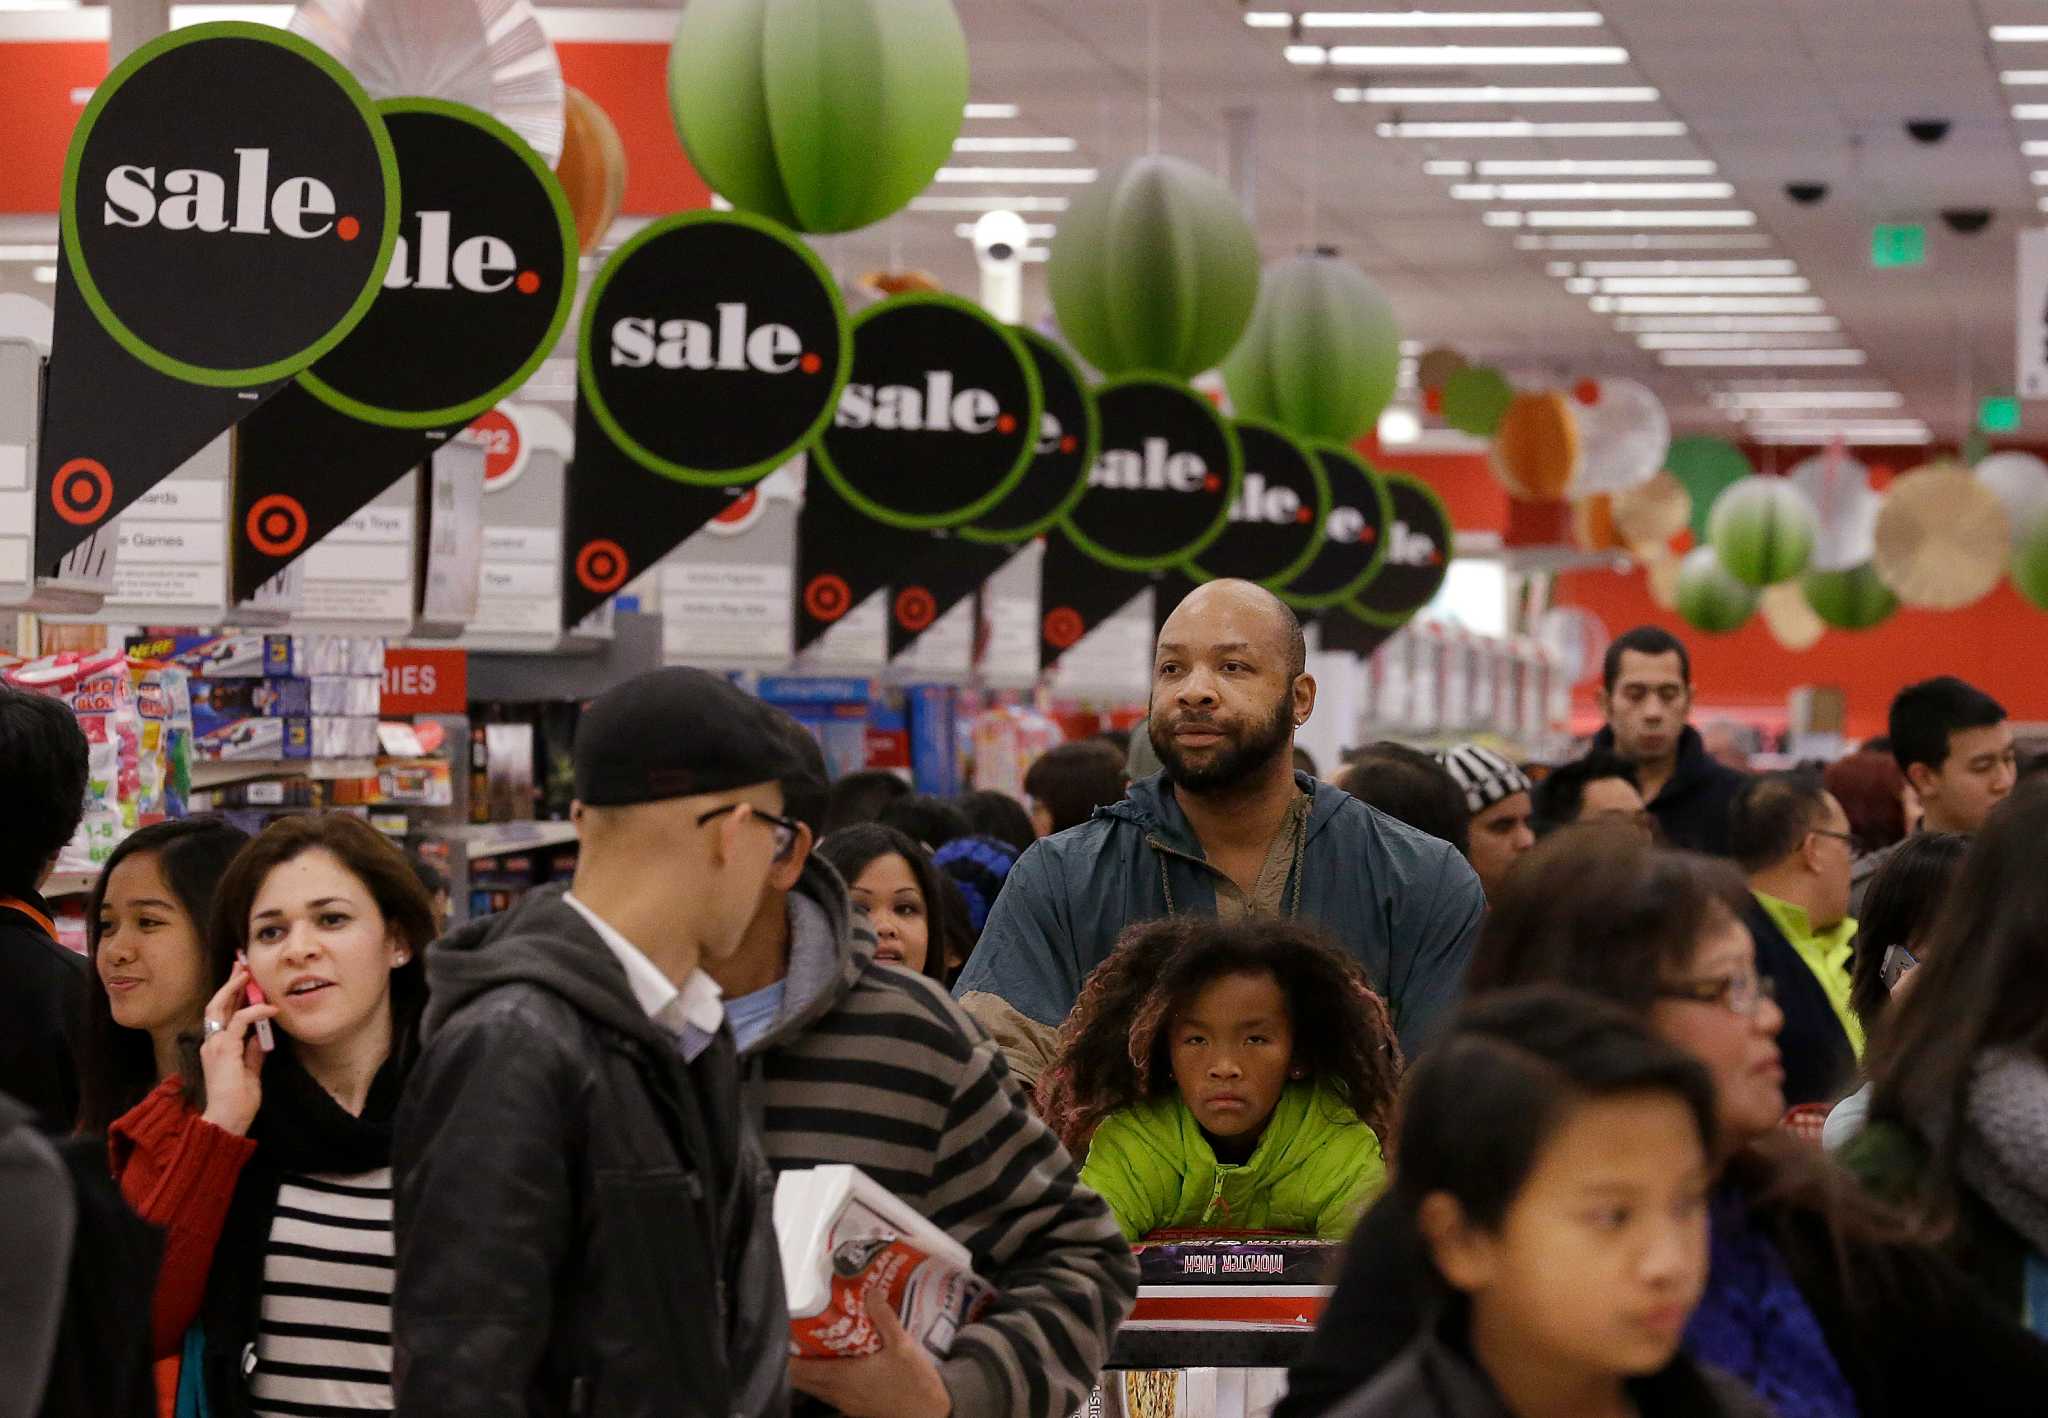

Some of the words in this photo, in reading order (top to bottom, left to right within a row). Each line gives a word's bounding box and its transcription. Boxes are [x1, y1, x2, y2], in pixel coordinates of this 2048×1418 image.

[104, 148, 360, 241] sale.
[383, 210, 541, 294] le.
[610, 302, 822, 375] sale.
[835, 370, 1017, 434] sale.
[1184, 1254, 1217, 1275] HIGH
[1221, 1254, 1284, 1275] MONSTER
